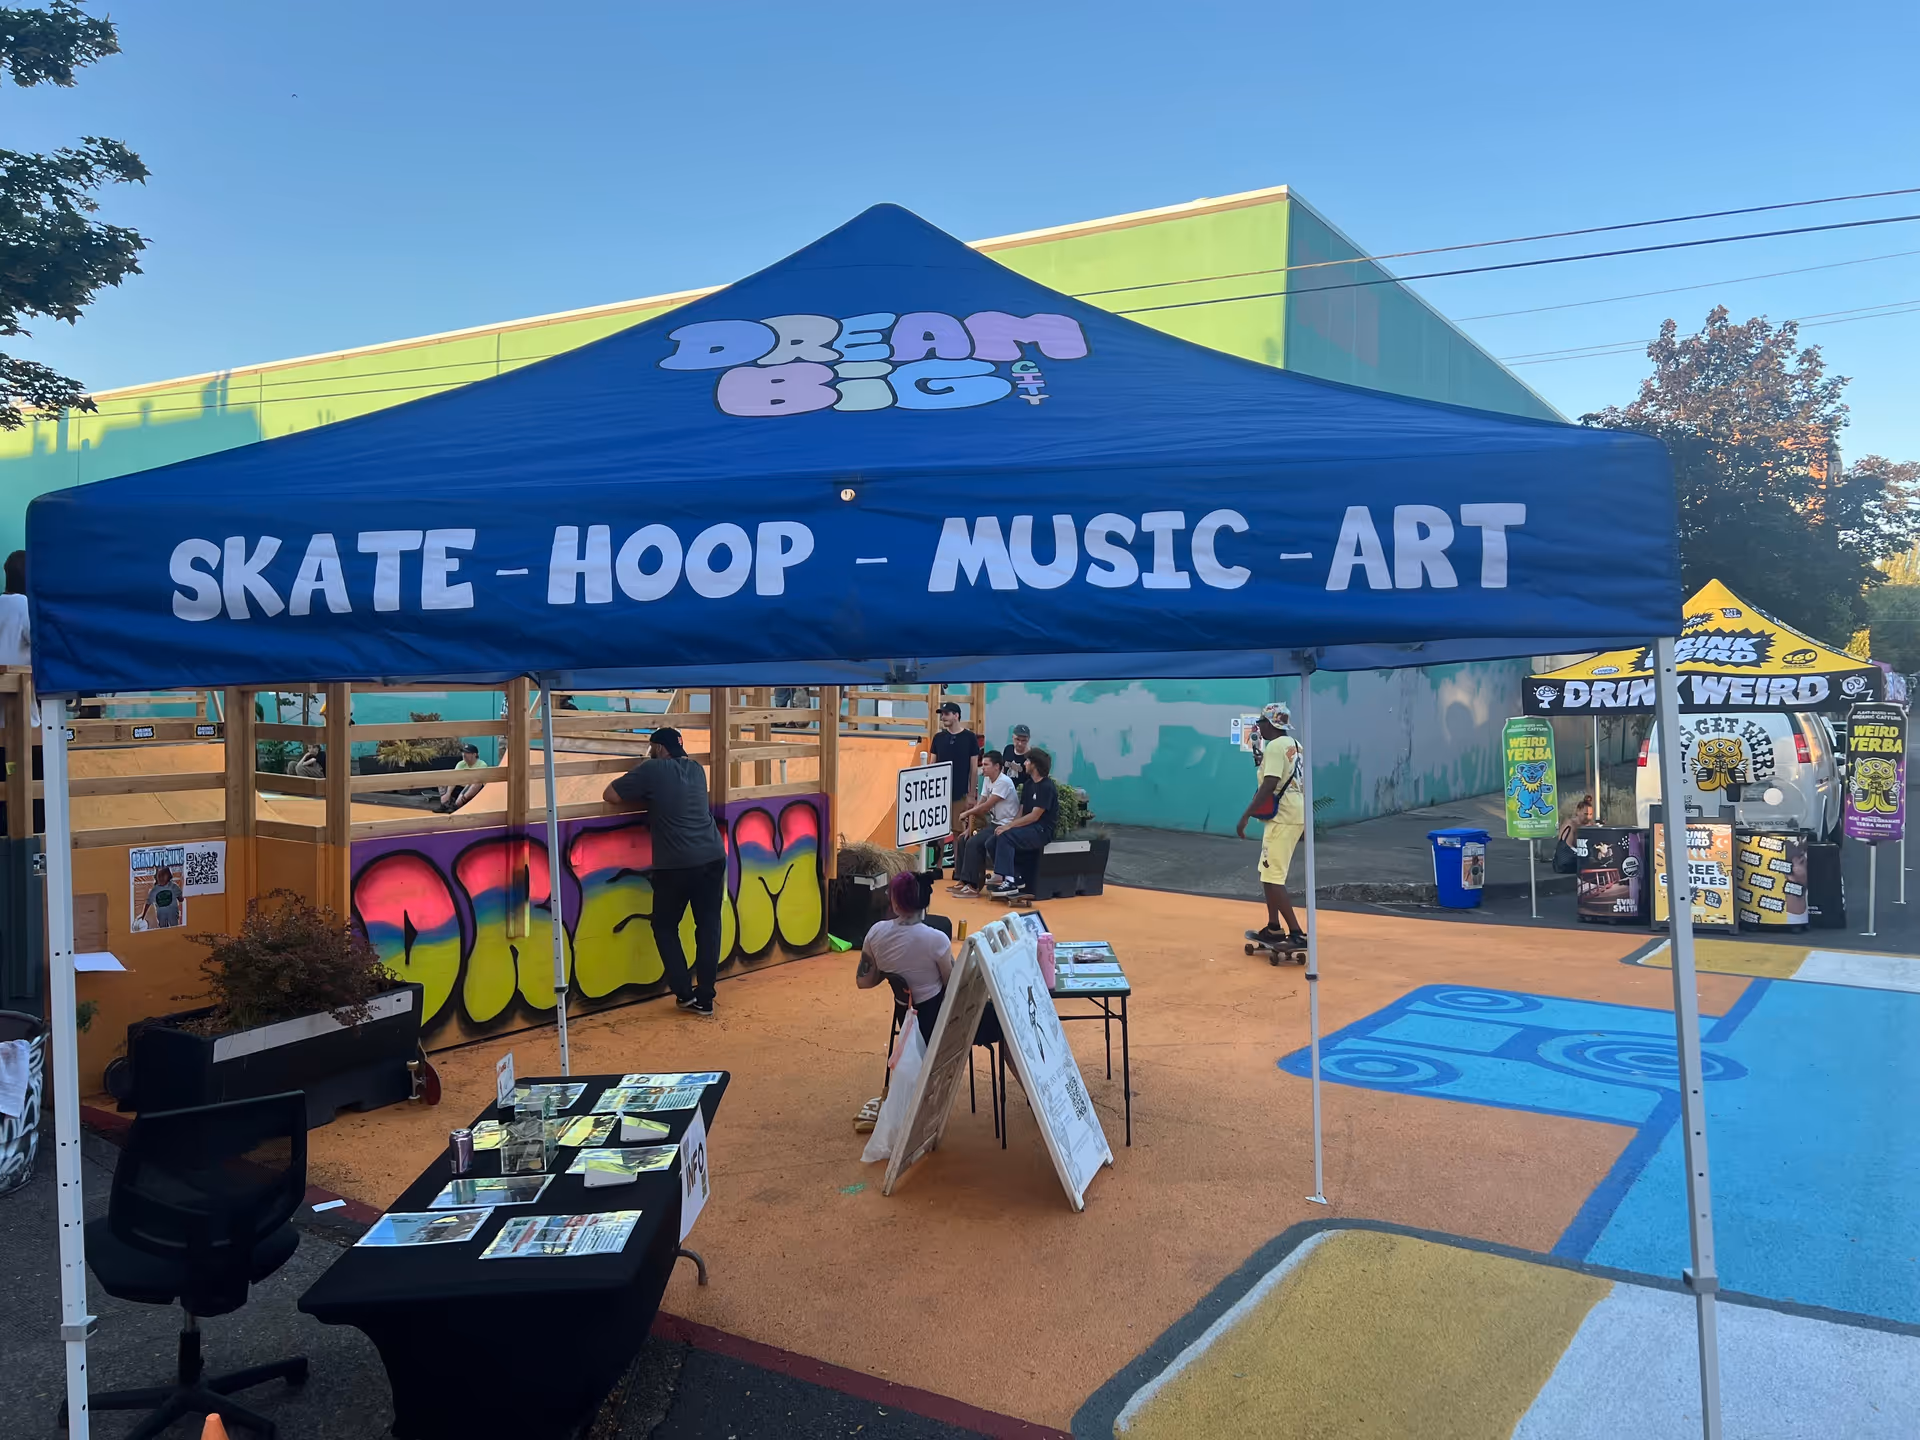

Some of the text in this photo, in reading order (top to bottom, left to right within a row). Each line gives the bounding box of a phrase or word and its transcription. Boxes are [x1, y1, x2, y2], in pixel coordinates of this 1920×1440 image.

[657, 311, 1090, 371] DREAM
[1011, 360, 1050, 405] CITY
[169, 527, 476, 621] SKATE
[547, 520, 815, 605] HOOP
[928, 508, 1252, 592] MUSIC
[1325, 502, 1527, 590] ART
[1674, 636, 1761, 654] RINK
[1691, 674, 1831, 706] WEIRD
[1694, 717, 1739, 735] GET
[1853, 725, 1899, 738] WEIRD
[1509, 736, 1547, 748] WEIRD
[1849, 737, 1902, 753] YERBA
[1506, 747, 1552, 761] YERBA
[904, 776, 948, 803] STREET
[902, 804, 948, 832] CLOSED
[1686, 831, 1710, 839] RINK
[1686, 838, 1710, 847] EIRD
[132, 852, 155, 869] GRAND
[154, 849, 184, 867] OPENING
[1688, 864, 1715, 876] REE
[685, 1141, 705, 1198] INFO
